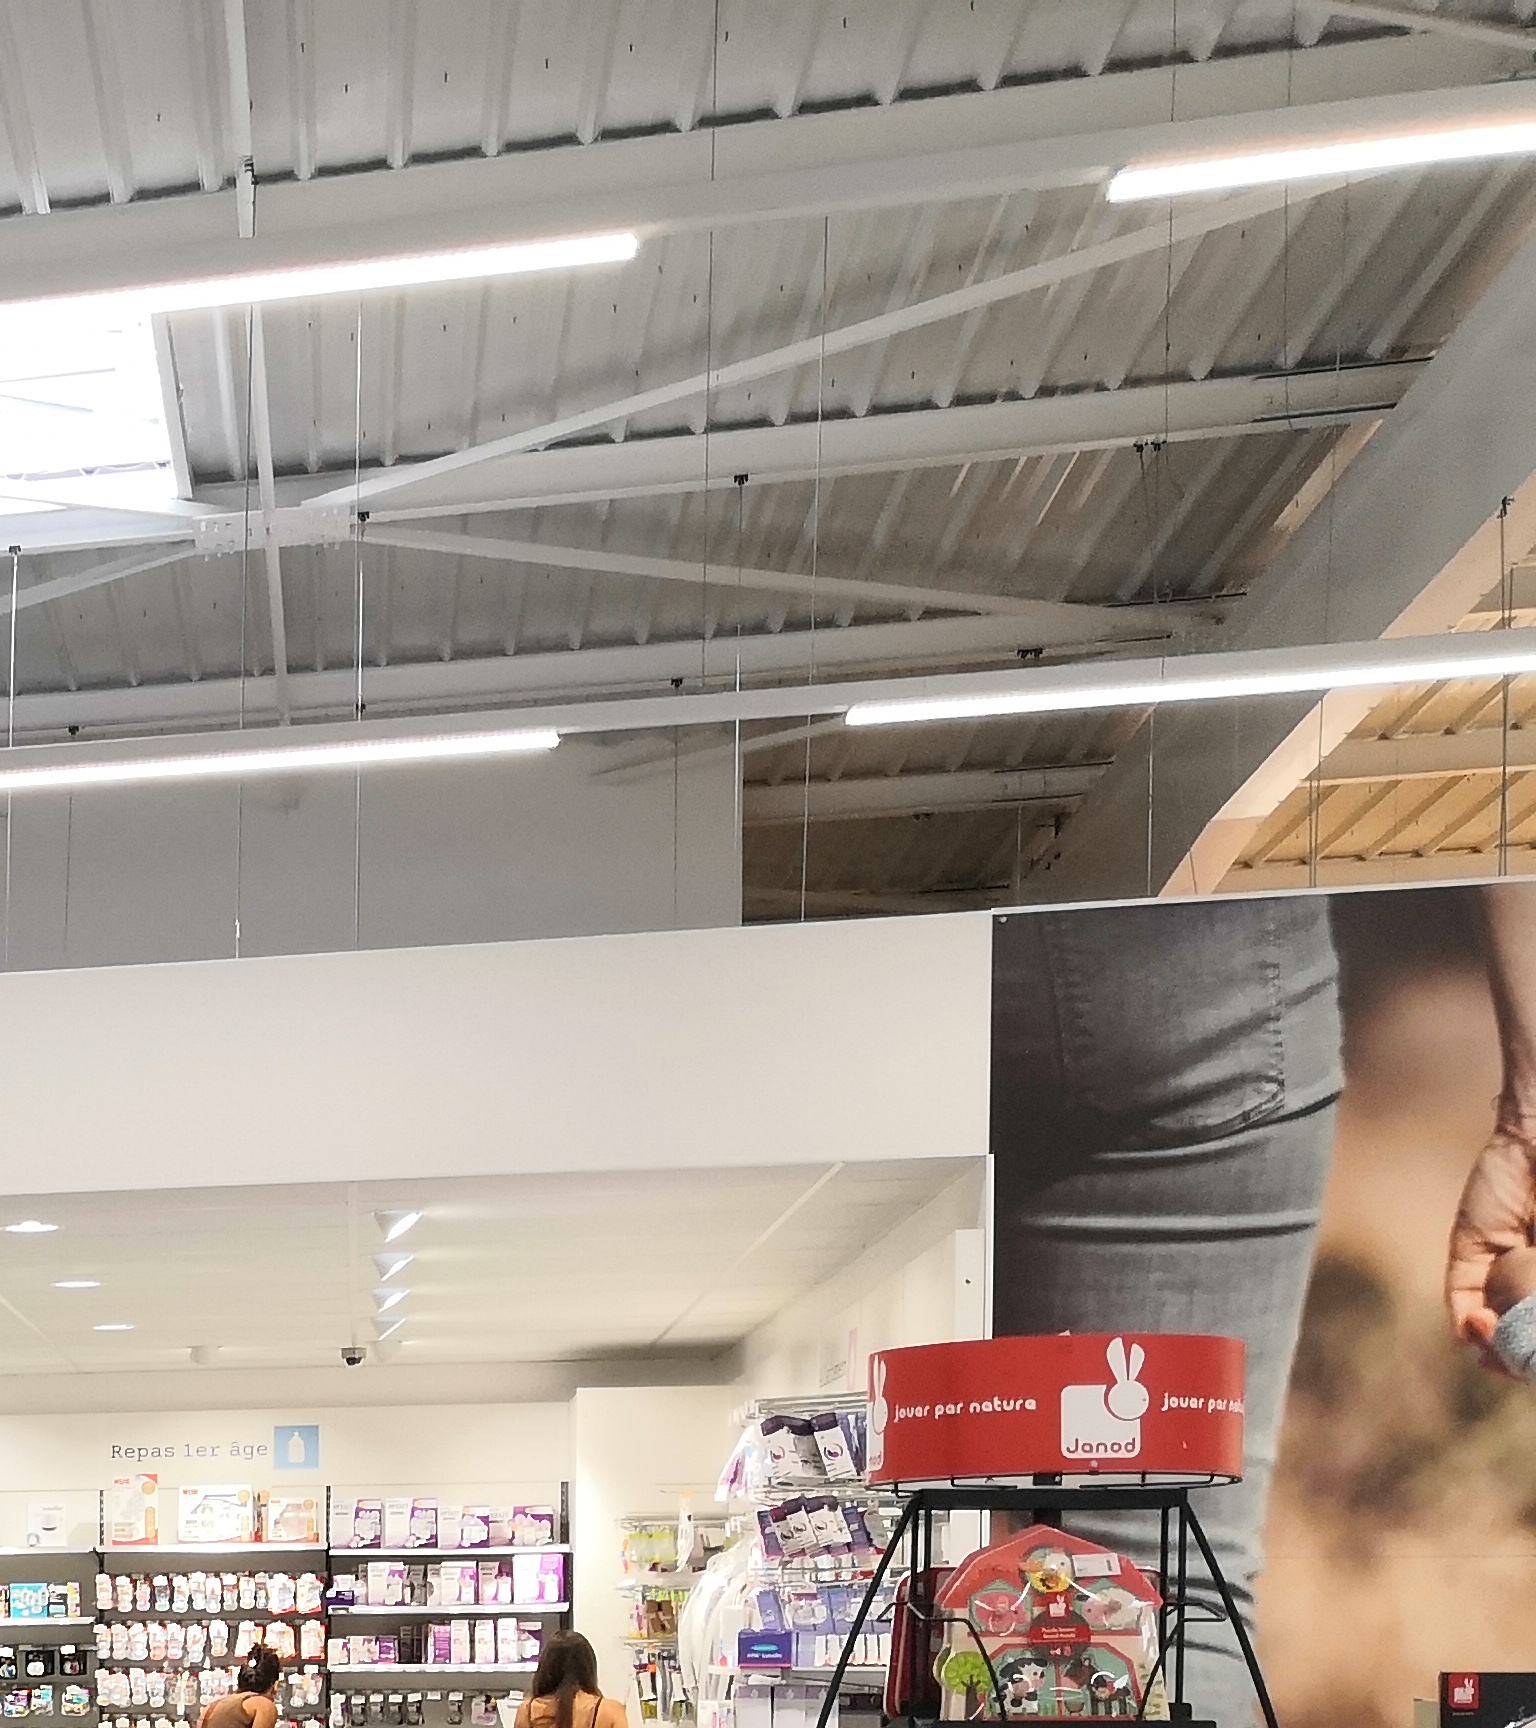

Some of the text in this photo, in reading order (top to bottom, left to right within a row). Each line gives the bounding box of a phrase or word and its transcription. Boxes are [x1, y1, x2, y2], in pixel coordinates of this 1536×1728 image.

[934, 1400, 964, 1419] par
[969, 1396, 1036, 1412] nature
[110, 1440, 269, 1461] Repas 1er âge
[1066, 1437, 1136, 1454] Janod
